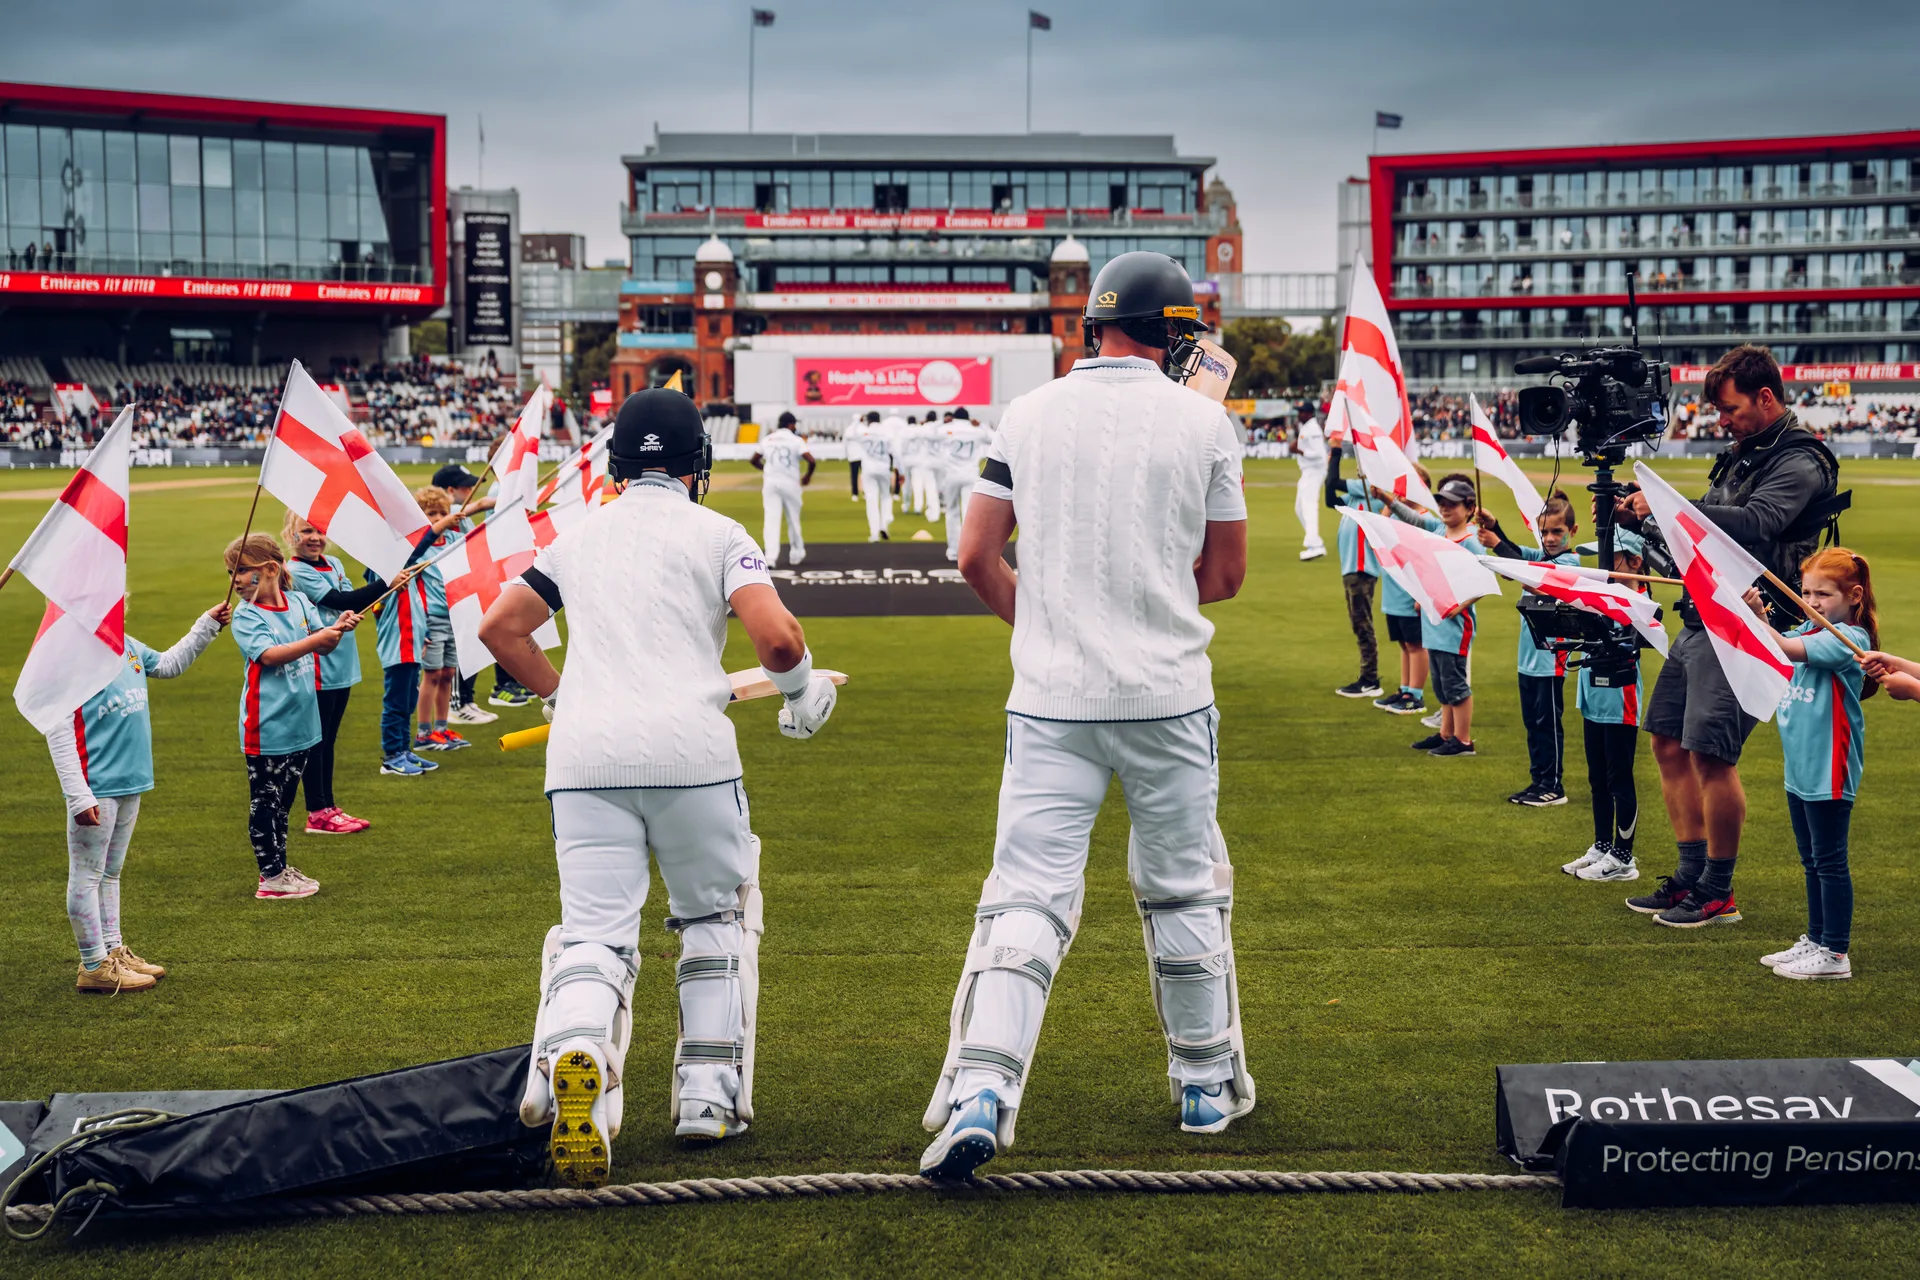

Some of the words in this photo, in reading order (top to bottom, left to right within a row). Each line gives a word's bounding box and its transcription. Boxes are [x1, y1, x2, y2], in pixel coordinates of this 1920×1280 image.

[41, 275, 100, 291] Emirates
[104, 278, 120, 291] FLY
[122, 278, 156, 293] BETTER
[183, 281, 240, 296] Emirates
[243, 282, 258, 296] FLY
[260, 284, 292, 297] BETTER
[318, 284, 370, 300] Emirates
[828, 370, 873, 385] Health
[875, 372, 886, 384] &
[888, 370, 916, 385] Life
[1795, 365, 1850, 381] Emirates
[98, 695, 126, 720] ALL
[1603, 1144, 1773, 1179] Protecting
